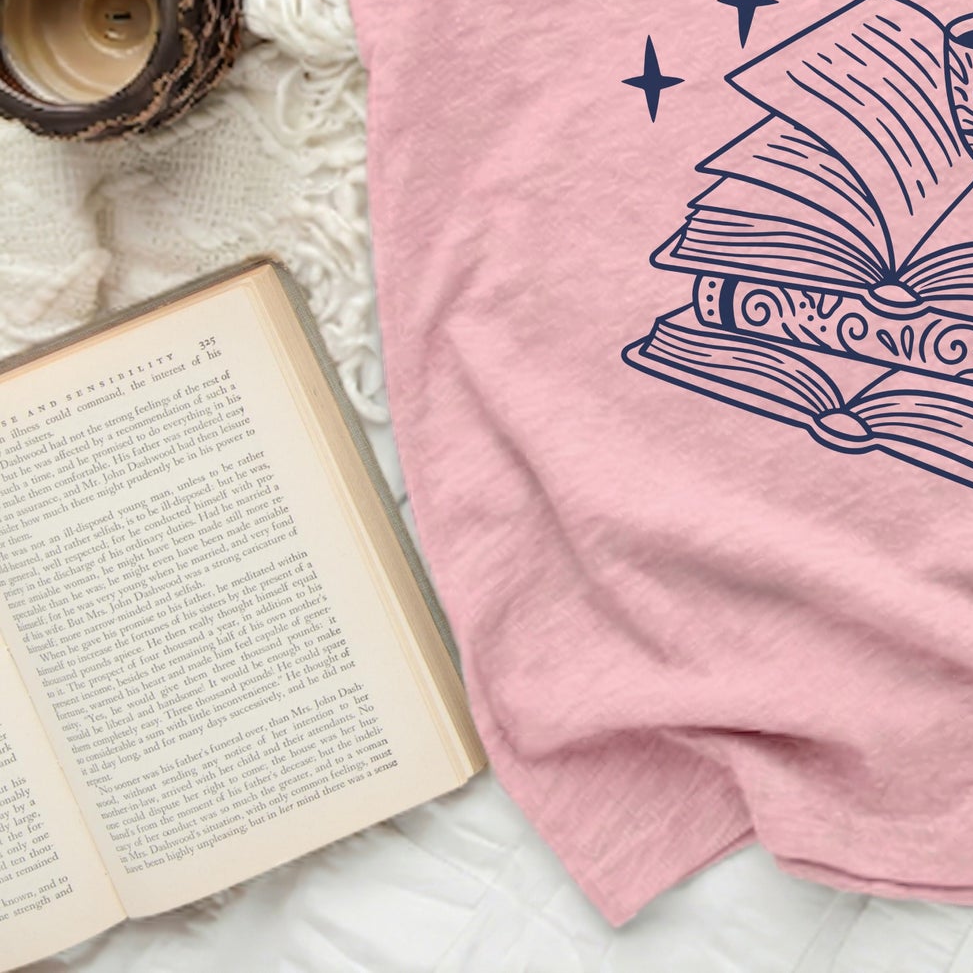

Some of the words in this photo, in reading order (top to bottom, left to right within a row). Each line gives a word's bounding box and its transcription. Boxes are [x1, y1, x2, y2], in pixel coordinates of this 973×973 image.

[10, 422, 40, 439] illness
[45, 407, 71, 425] could
[130, 379, 146, 390] the
[151, 361, 185, 382] interest
[206, 349, 222, 359] his
[27, 400, 57, 416] AND
[66, 352, 173, 401] SENSIBILITY
[198, 335, 216, 350] 325
[104, 411, 134, 428] strong
[134, 396, 171, 415] feelings
[202, 374, 219, 388] rest
[54, 439, 90, 462] affected
[115, 401, 191, 436] recommendation
[205, 383, 227, 400] such
[92, 435, 134, 462] promised
[162, 406, 212, 431] everything
[226, 394, 241, 405] his
[127, 444, 176, 472] Dashwood
[219, 417, 250, 434] leisure
[131, 440, 160, 456] father
[183, 412, 223, 436] rendered
[225, 406, 245, 418] easy
[70, 494, 95, 508] there
[96, 480, 124, 498] might
[126, 461, 172, 488] prudently
[216, 432, 243, 451] power
[118, 499, 148, 519] young
[177, 475, 206, 491] unless
[237, 450, 264, 466] rather
[144, 504, 191, 531] conducted
[193, 489, 228, 510] himself
[231, 478, 253, 495] with
[51, 560, 95, 581] discharge
[125, 531, 165, 552] ordinary
[236, 484, 271, 506] married
[63, 535, 91, 551] rather
[117, 551, 145, 569] might
[225, 509, 243, 524] still
[246, 501, 269, 515] more
[118, 578, 148, 598] young
[250, 527, 271, 540] very
[271, 514, 294, 530] fond
[122, 562, 150, 580] might
[253, 505, 289, 525] amiable
[133, 574, 182, 601] Dashwood
[212, 553, 241, 569] strong
[242, 533, 286, 557] caricature
[76, 644, 112, 663] increase
[130, 621, 169, 642] fortunes
[199, 597, 226, 614] sisters
[259, 567, 292, 591] present
[80, 657, 111, 678] pounds
[189, 615, 215, 631] really
[216, 597, 253, 619] thought
[255, 581, 289, 603] himself
[292, 569, 317, 588] equal
[119, 614, 155, 636] promise
[231, 561, 275, 587] meditated
[278, 550, 307, 567] within
[88, 664, 124, 688] prospect
[162, 630, 205, 655] thousand
[255, 595, 292, 616] addition
[89, 689, 124, 710] warmed
[141, 674, 166, 690] heart
[254, 622, 289, 643] capable
[116, 669, 149, 687] besides
[168, 642, 216, 666] remaining
[127, 690, 155, 709] would
[211, 658, 236, 673] three
[240, 636, 282, 661] thousand
[105, 711, 134, 730] liberal
[220, 663, 249, 683] would
[266, 641, 301, 664] enough
[317, 626, 341, 642] make
[166, 703, 193, 719] Three
[194, 681, 237, 707] thousand
[295, 646, 320, 665] could
[322, 638, 346, 654] spare
[188, 708, 211, 722] little
[302, 652, 339, 674] thought
[123, 781, 157, 800] without
[161, 767, 198, 786] sending
[224, 743, 252, 760] notice
[292, 708, 334, 731] intention
[178, 725, 205, 740] many
[205, 715, 227, 728] days
[209, 731, 243, 753] funeral
[147, 799, 180, 817] dispute
[202, 779, 225, 795] right
[289, 742, 316, 757] house
[161, 778, 192, 799] arrived
[237, 749, 260, 767] child
[282, 734, 304, 748] their
[162, 817, 197, 837] conduct
[356, 738, 388, 756] woman
[290, 775, 329, 796] common
[370, 747, 392, 763] must
[166, 845, 196, 861] highly
[296, 789, 320, 807] mind
[321, 781, 345, 796] there
[374, 759, 398, 774] sense
[177, 797, 213, 818] moment
[7, 841, 29, 855] only
[16, 852, 59, 877] remained
[13, 893, 51, 916] strength
[55, 883, 73, 898] and
[38, 878, 56, 893] and
